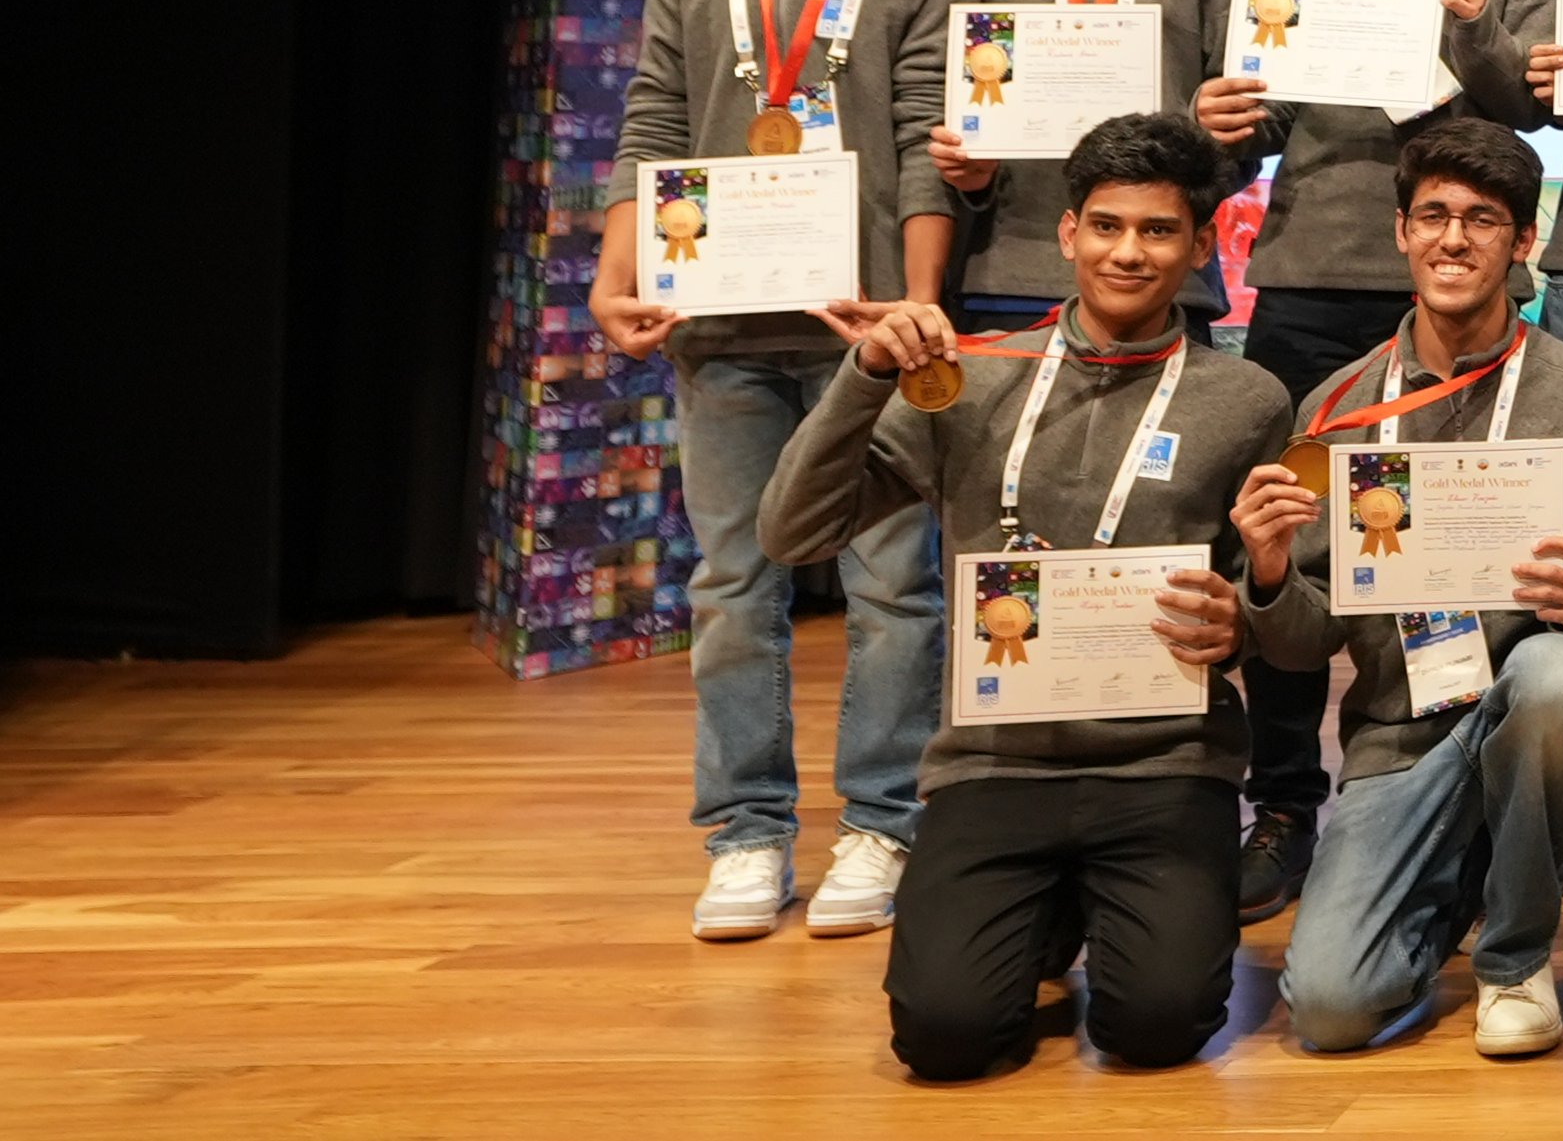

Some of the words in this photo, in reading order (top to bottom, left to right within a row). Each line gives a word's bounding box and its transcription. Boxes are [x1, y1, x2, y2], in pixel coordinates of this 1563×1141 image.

[1423, 477, 1449, 489] Gold
[1487, 477, 1532, 488] Winner
[1120, 585, 1165, 596] Winne
